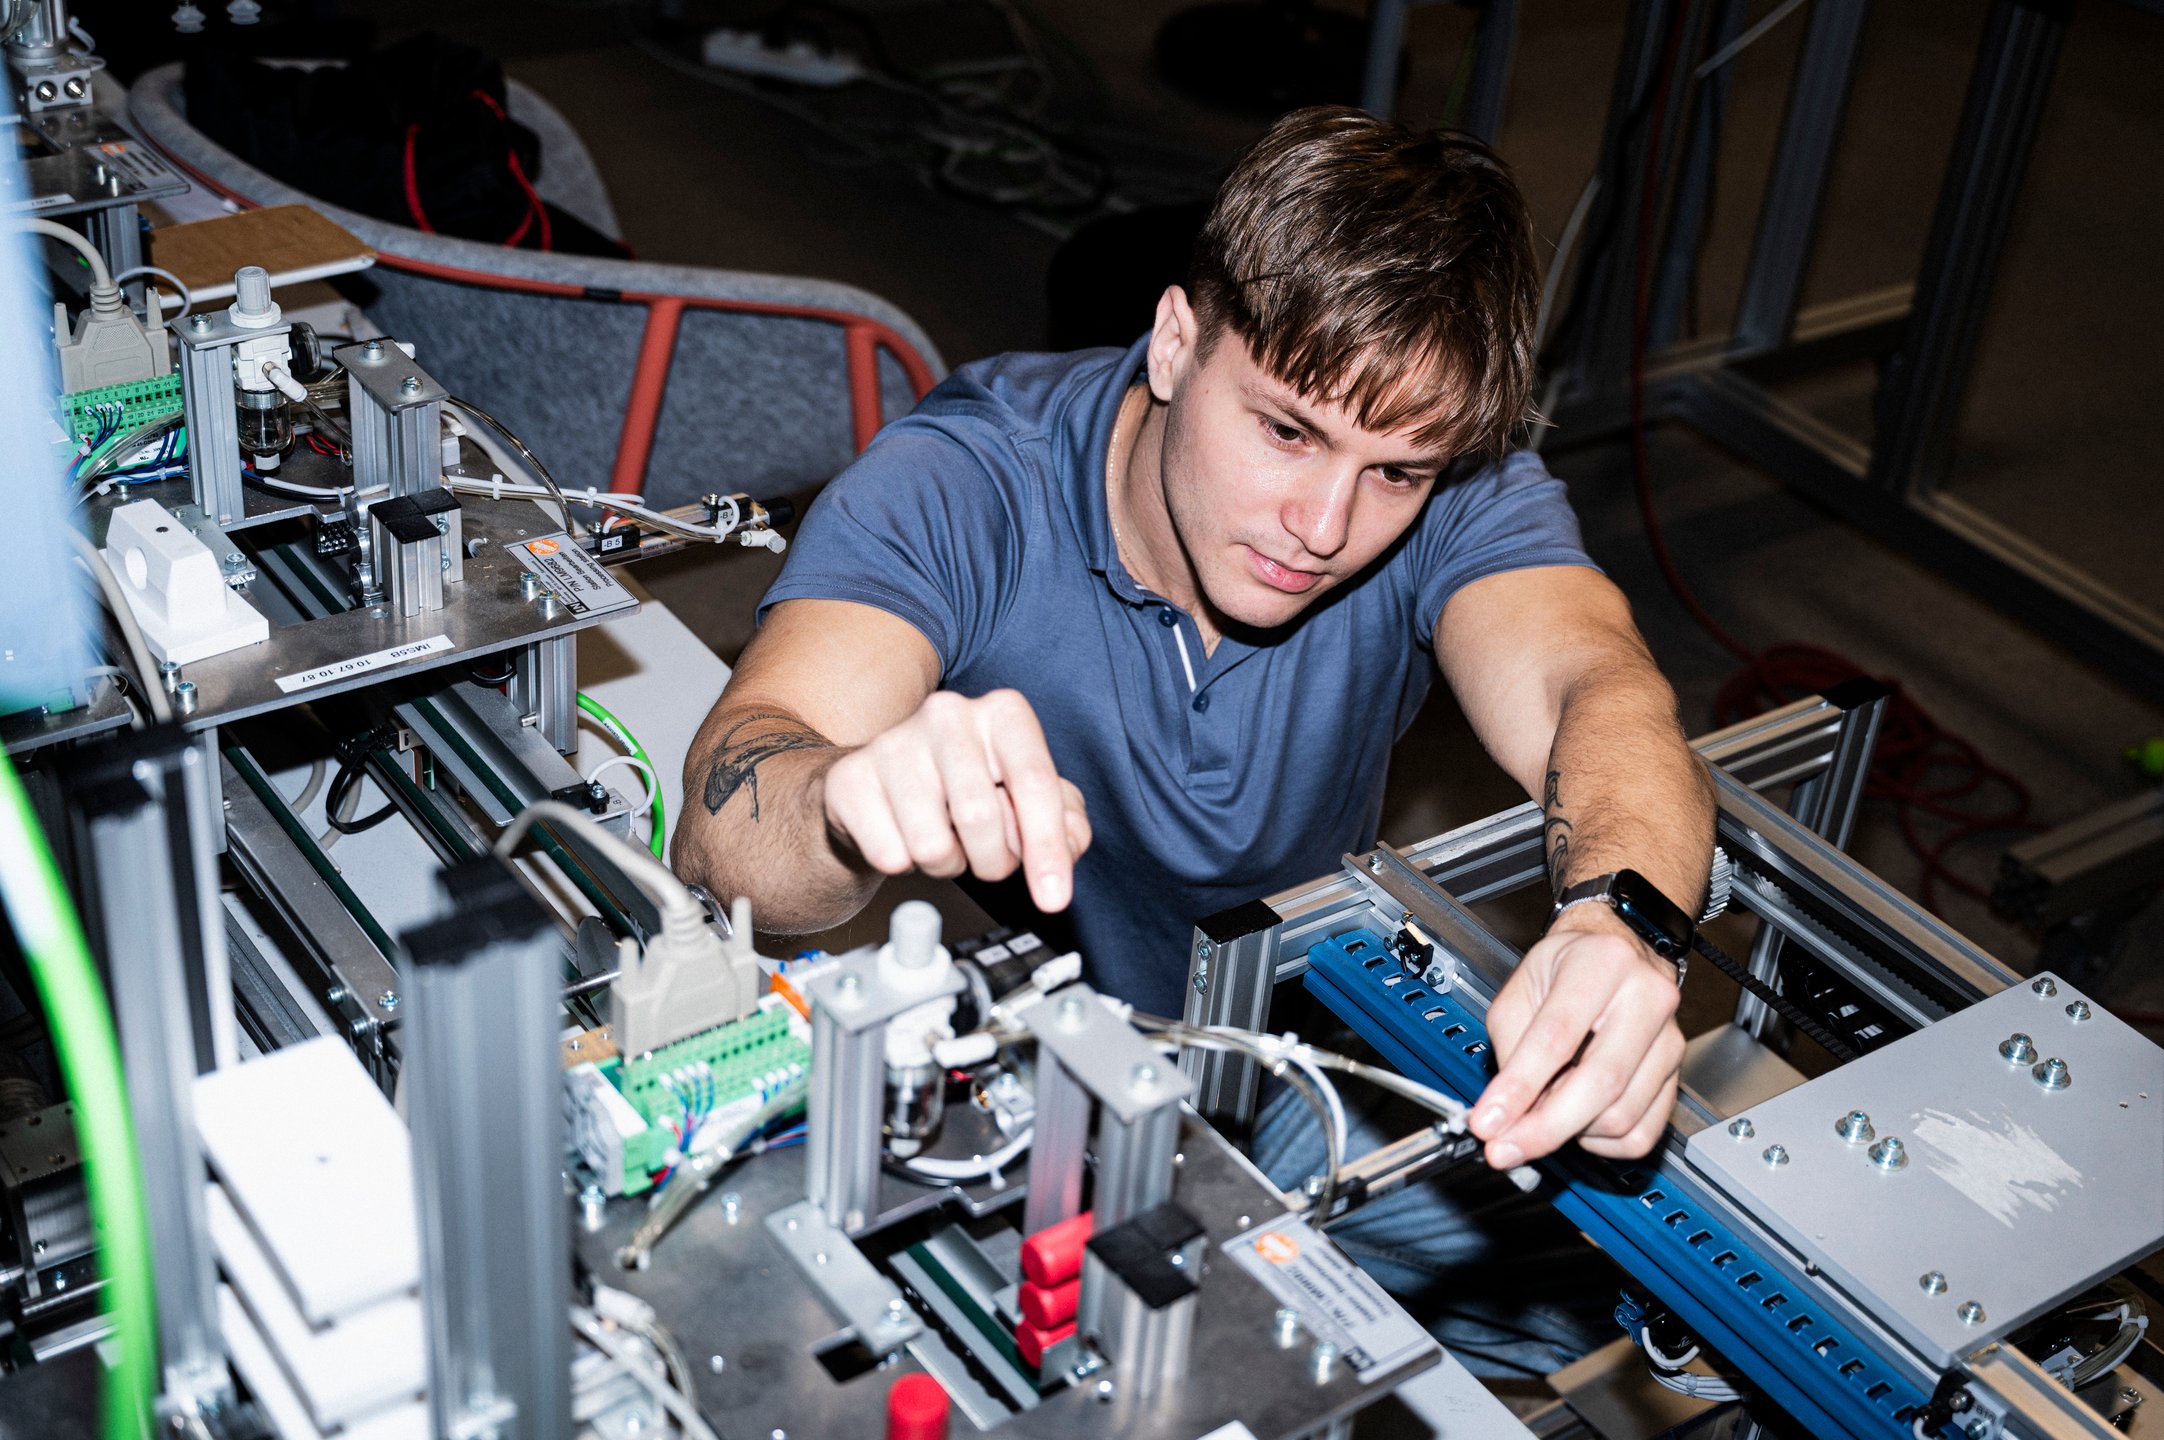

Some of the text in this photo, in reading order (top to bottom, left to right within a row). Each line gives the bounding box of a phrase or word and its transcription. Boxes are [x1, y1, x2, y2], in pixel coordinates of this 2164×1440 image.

[559, 551, 582, 575] Bearbeiten
[571, 548, 589, 564] station
[544, 557, 573, 581] LM9682
[587, 562, 614, 587] Processing
[568, 580, 584, 593] P/N
[582, 575, 601, 590] Station
[301, 643, 431, 682] IMS5B 10.67.10.87
